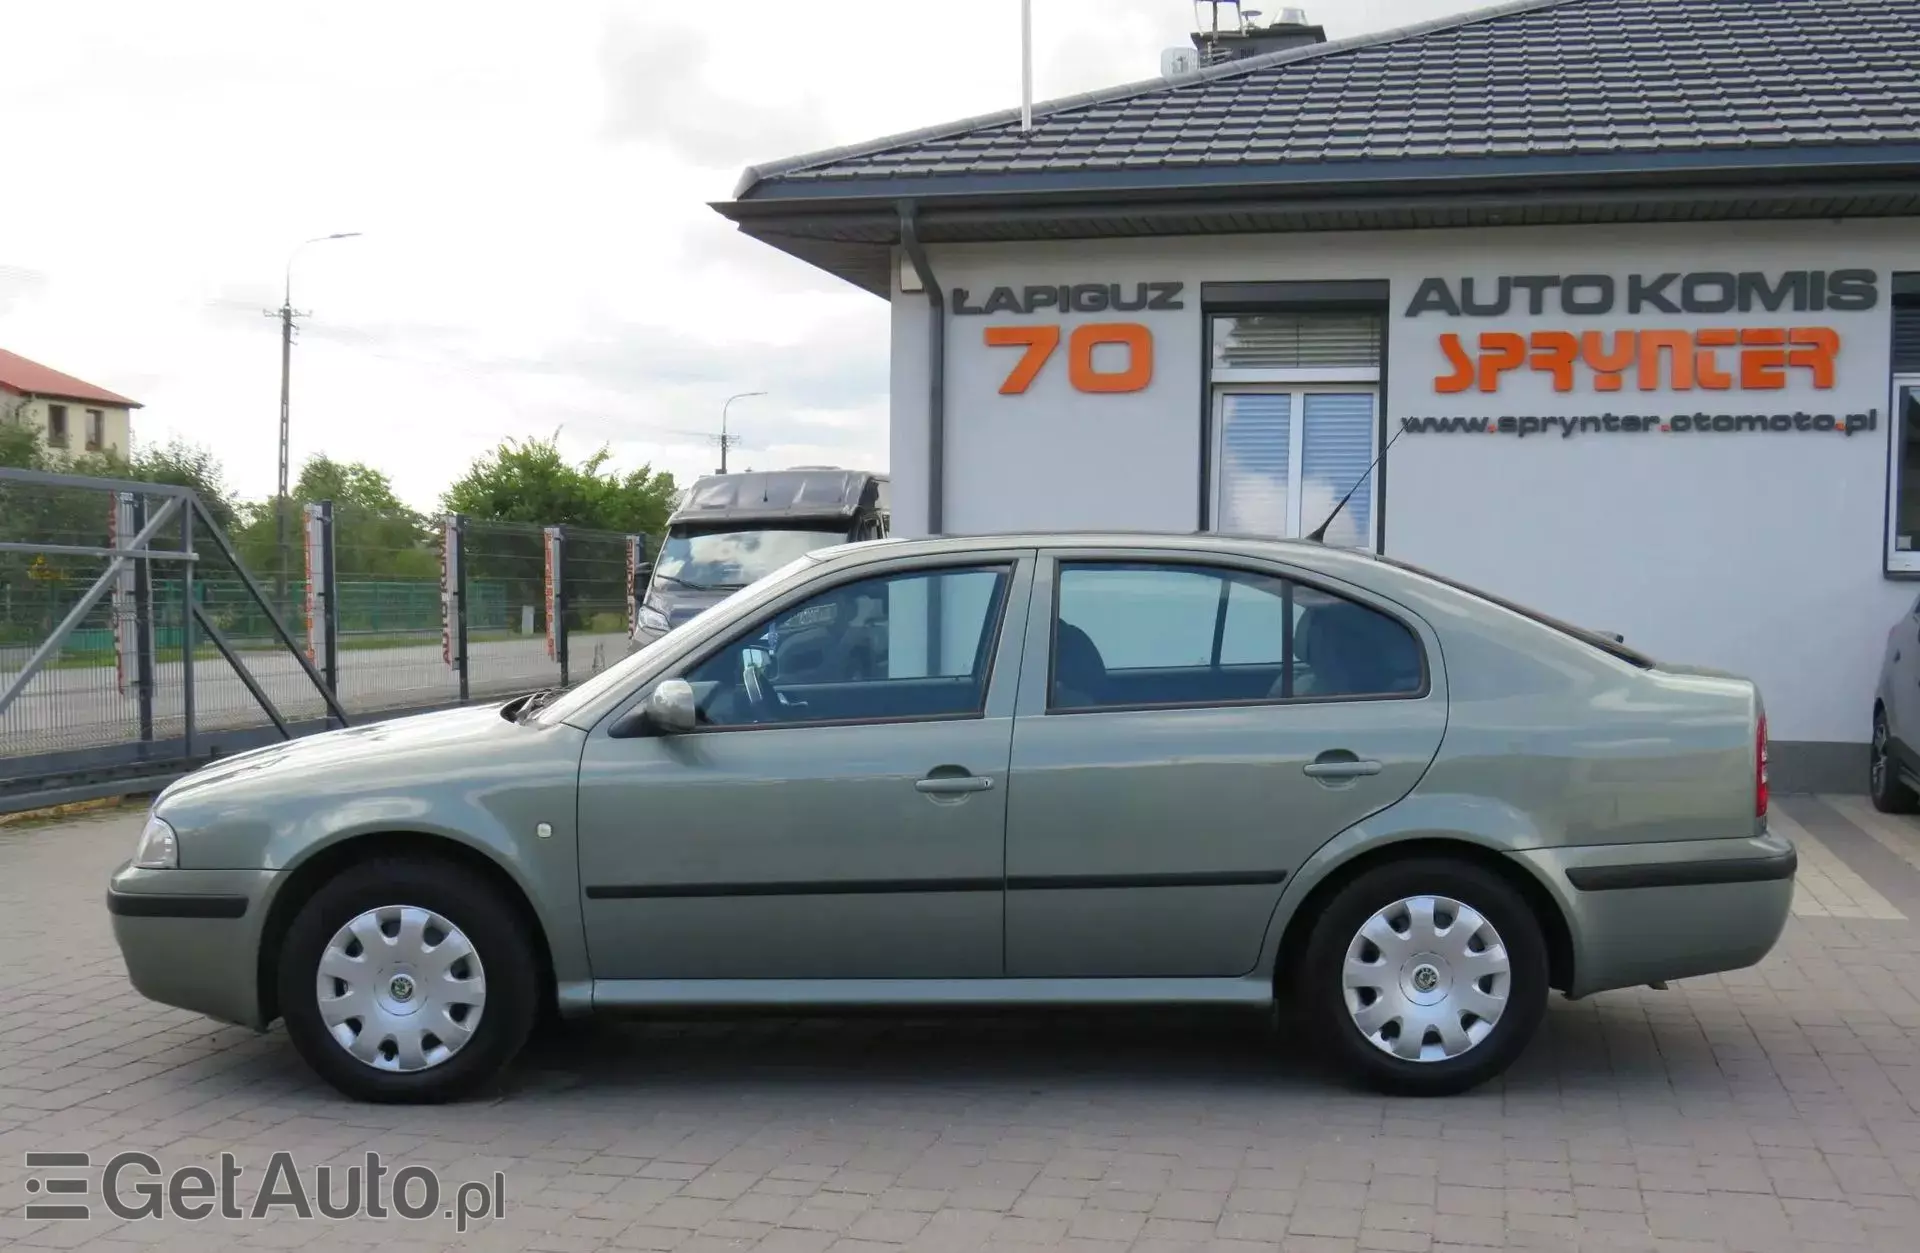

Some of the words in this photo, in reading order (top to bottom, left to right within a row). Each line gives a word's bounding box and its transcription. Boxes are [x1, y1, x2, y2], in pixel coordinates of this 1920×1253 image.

[952, 281, 1184, 315] ŁAPIGUZ
[1404, 274, 1615, 317] AUTO
[1628, 268, 1878, 314] KOMIS
[983, 322, 1154, 395] 70
[1433, 326, 1840, 393] SPRYNTER
[1401, 408, 1878, 438] www.sprynter.otomoto.pl
